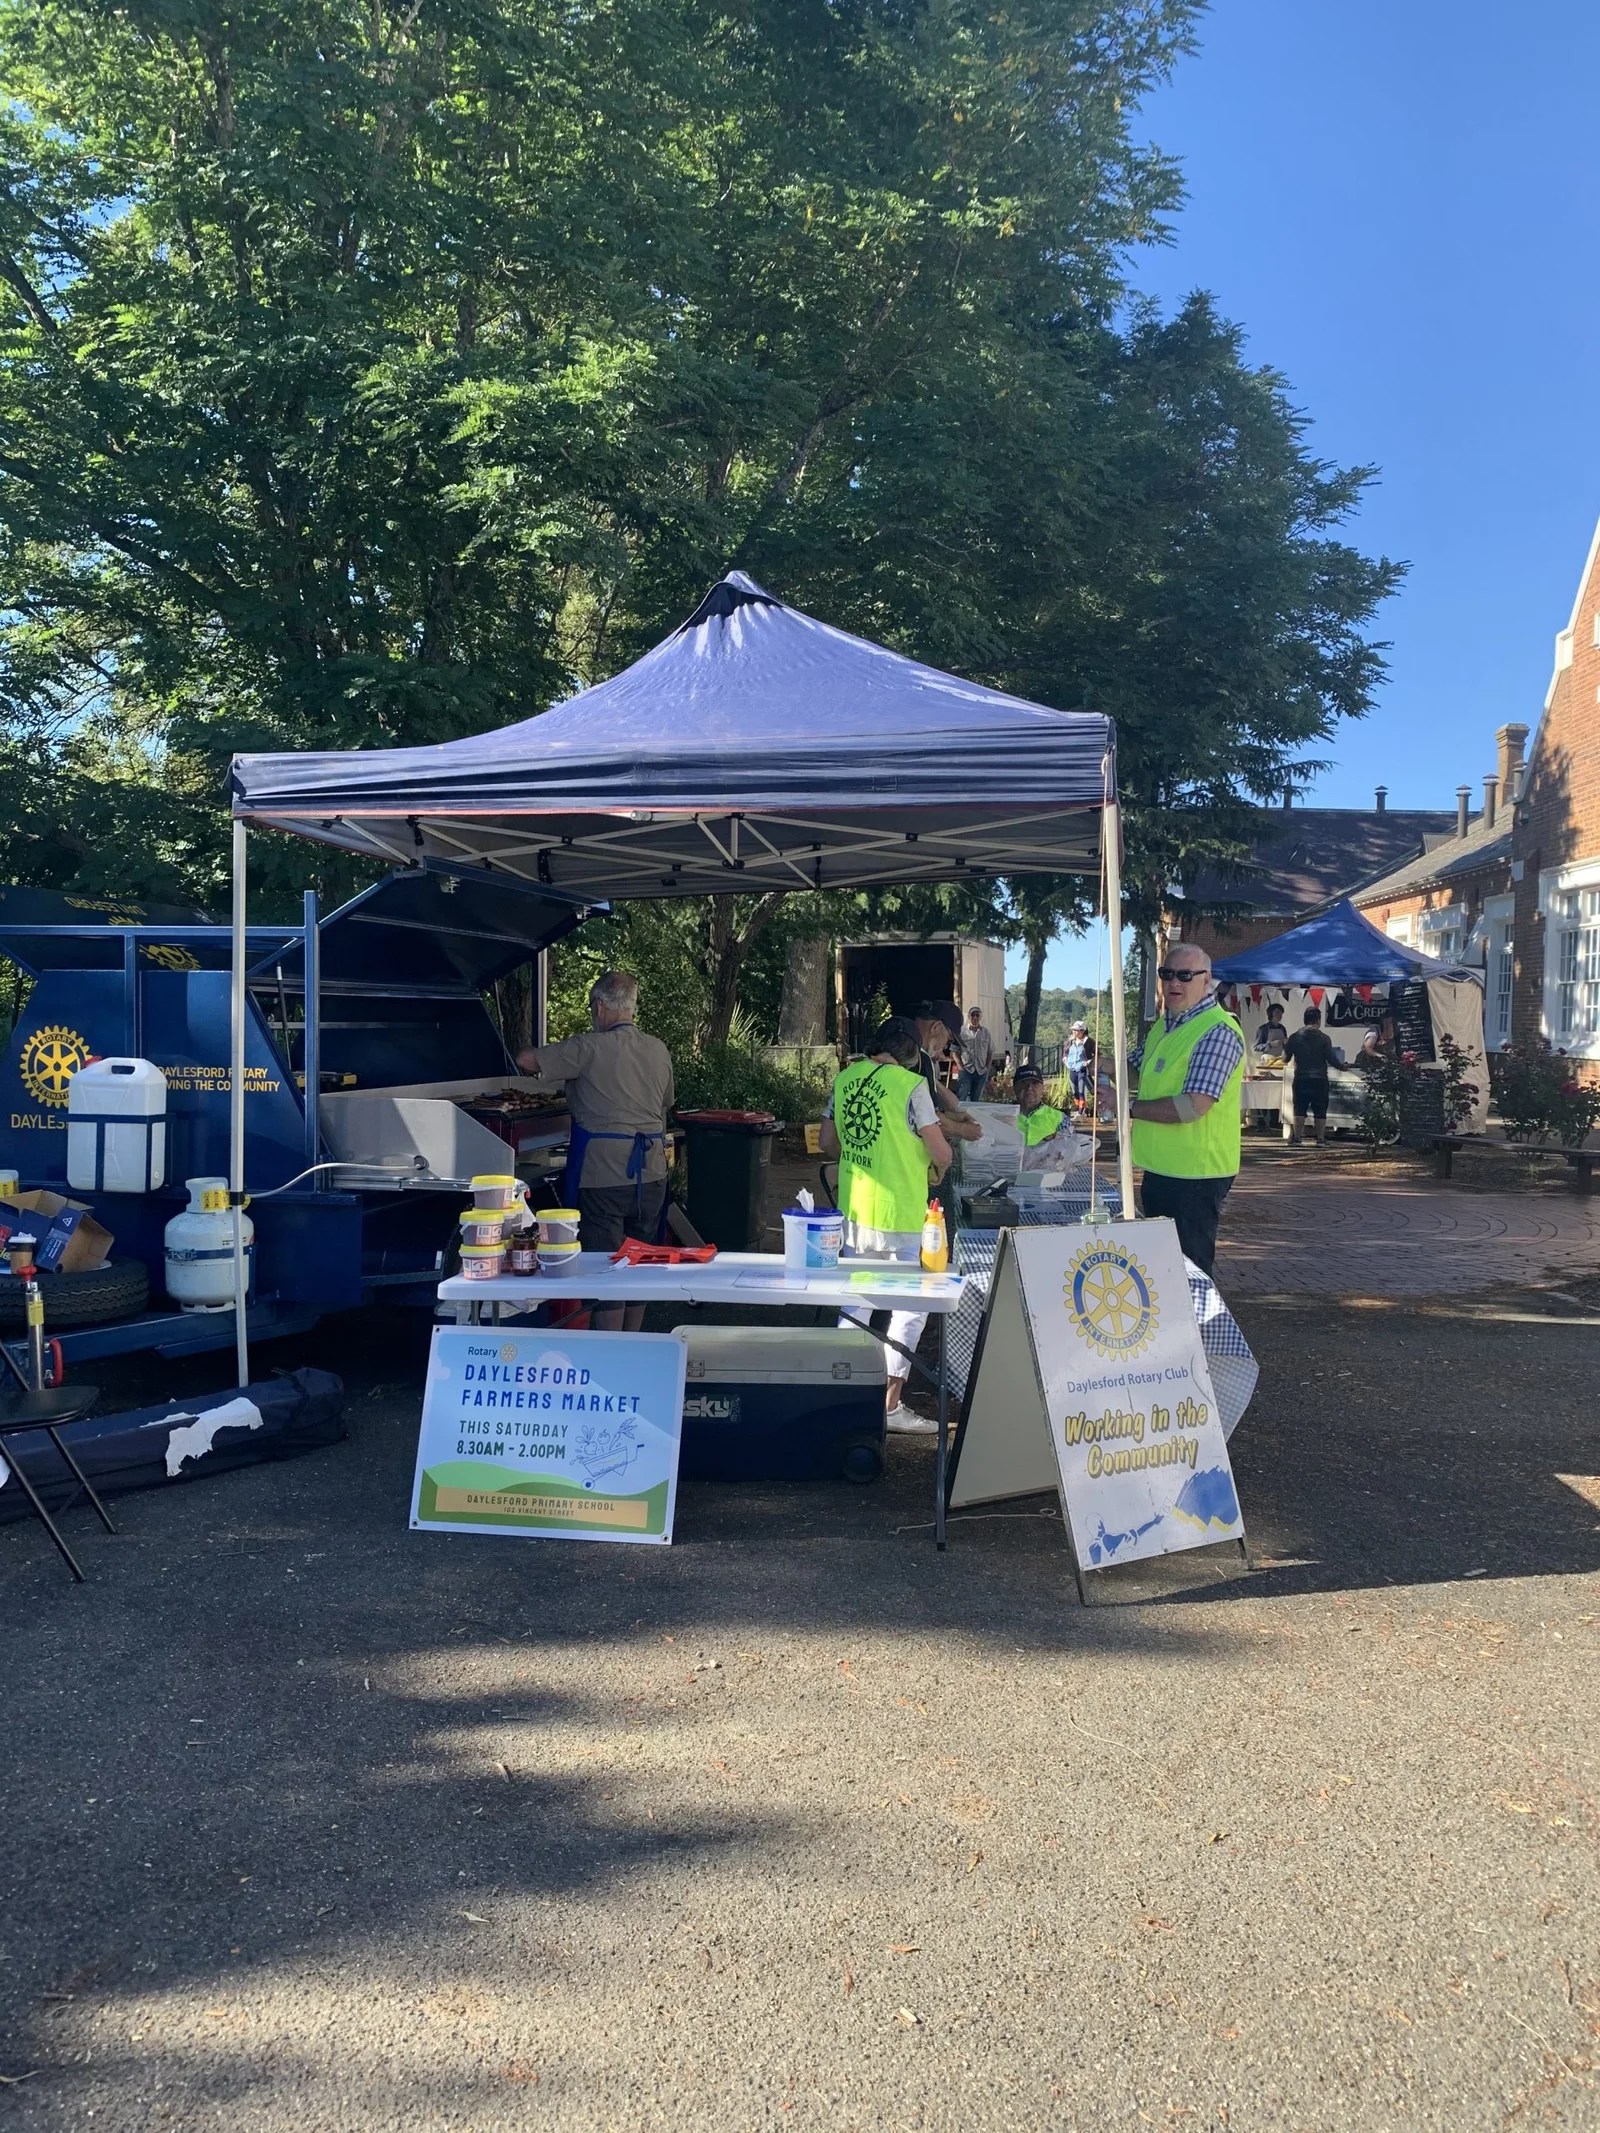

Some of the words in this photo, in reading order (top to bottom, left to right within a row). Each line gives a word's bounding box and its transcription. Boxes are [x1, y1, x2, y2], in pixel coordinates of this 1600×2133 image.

[41, 1033, 74, 1046] ROTARY
[158, 1066, 226, 1078] DAYLESFORD
[228, 1067, 268, 1079] RTARY
[195, 1080, 214, 1091] THE
[842, 1150, 851, 1161] AT
[1084, 1251, 1125, 1269] ROTARY
[1084, 1311, 1151, 1350] INTERNATIONAL
[468, 1346, 498, 1358] Rotary
[465, 1364, 591, 1385] DAYLESFORD
[1067, 1373, 1126, 1395] Daylesford
[1128, 1370, 1163, 1389] Rotary
[1164, 1366, 1189, 1382] Club
[461, 1389, 552, 1410] FARMERS
[562, 1393, 641, 1413] MARKET
[683, 1396, 730, 1418] sky
[459, 1420, 490, 1434] THIS
[496, 1422, 569, 1438] SATURDAY
[1065, 1410, 1146, 1446] Working
[1152, 1405, 1171, 1432] in
[1176, 1397, 1209, 1428] the
[456, 1441, 504, 1456] 8.30AM
[518, 1443, 566, 1459] 2.00PM
[1087, 1438, 1199, 1479] Community
[467, 1494, 528, 1507] DAYLESFORD
[531, 1497, 575, 1509] PRIMARY
[577, 1500, 616, 1511] SCHOOL
[549, 1509, 575, 1517] STREET
